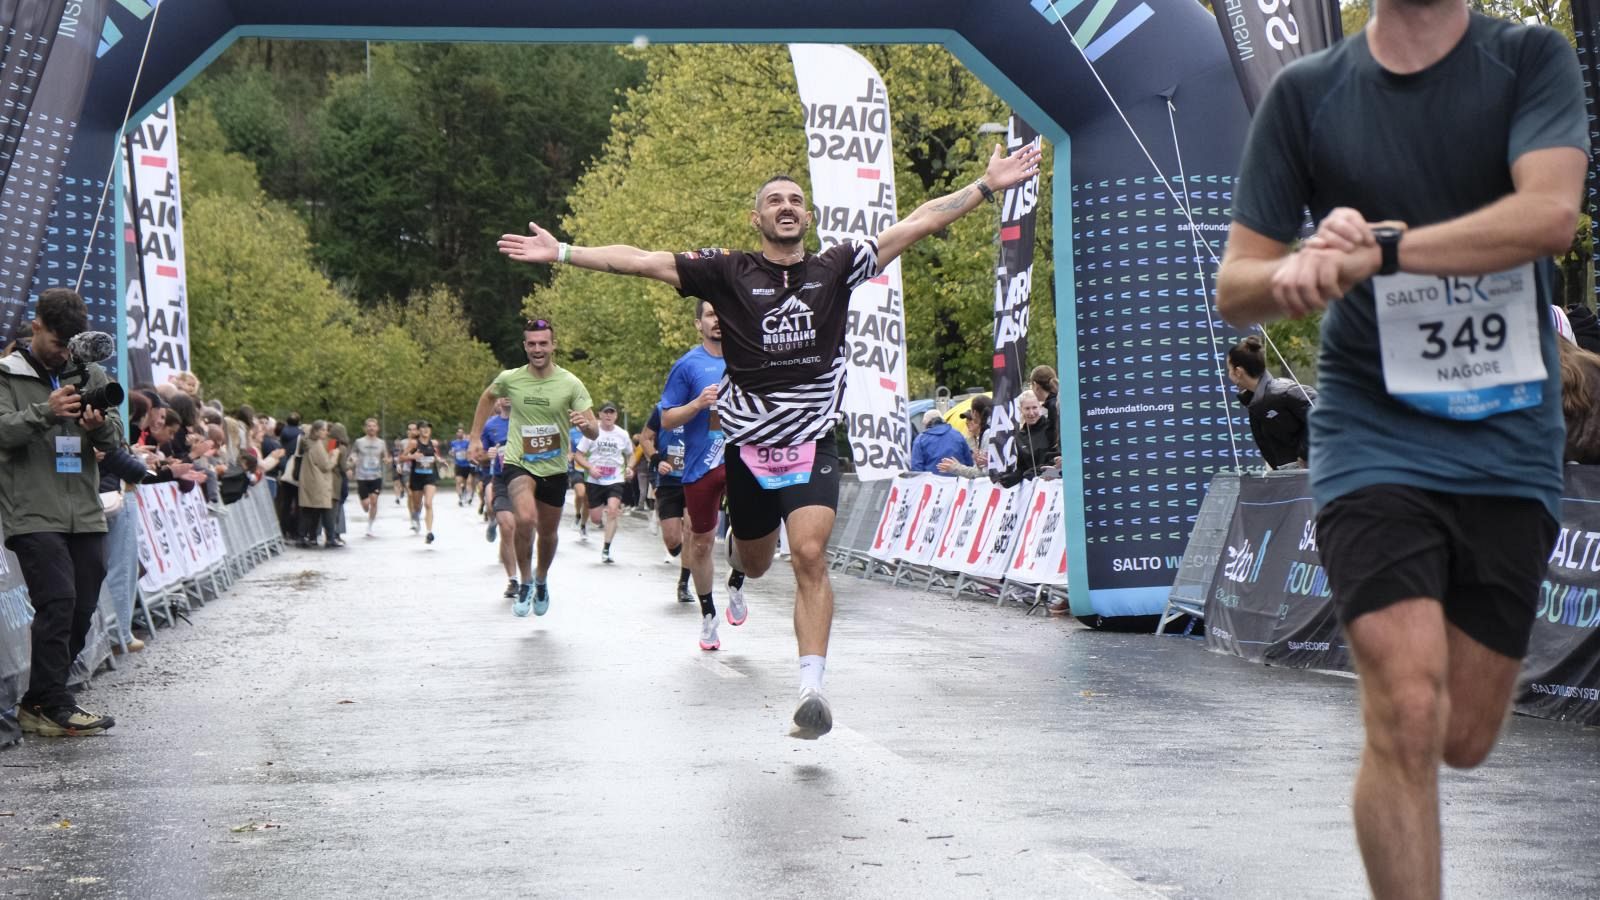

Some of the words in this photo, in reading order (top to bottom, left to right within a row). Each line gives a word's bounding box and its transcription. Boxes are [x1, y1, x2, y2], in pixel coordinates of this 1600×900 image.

[1386, 287, 1439, 307] SALTO
[762, 311, 814, 334] CATT
[1419, 312, 1507, 360] 349
[771, 355, 821, 367] NORDPLASTIC
[1437, 361, 1502, 382] NAGORE
[1087, 402, 1175, 416] saltofoundation.org
[757, 446, 799, 464] 966
[1113, 557, 1161, 572] SALTO
